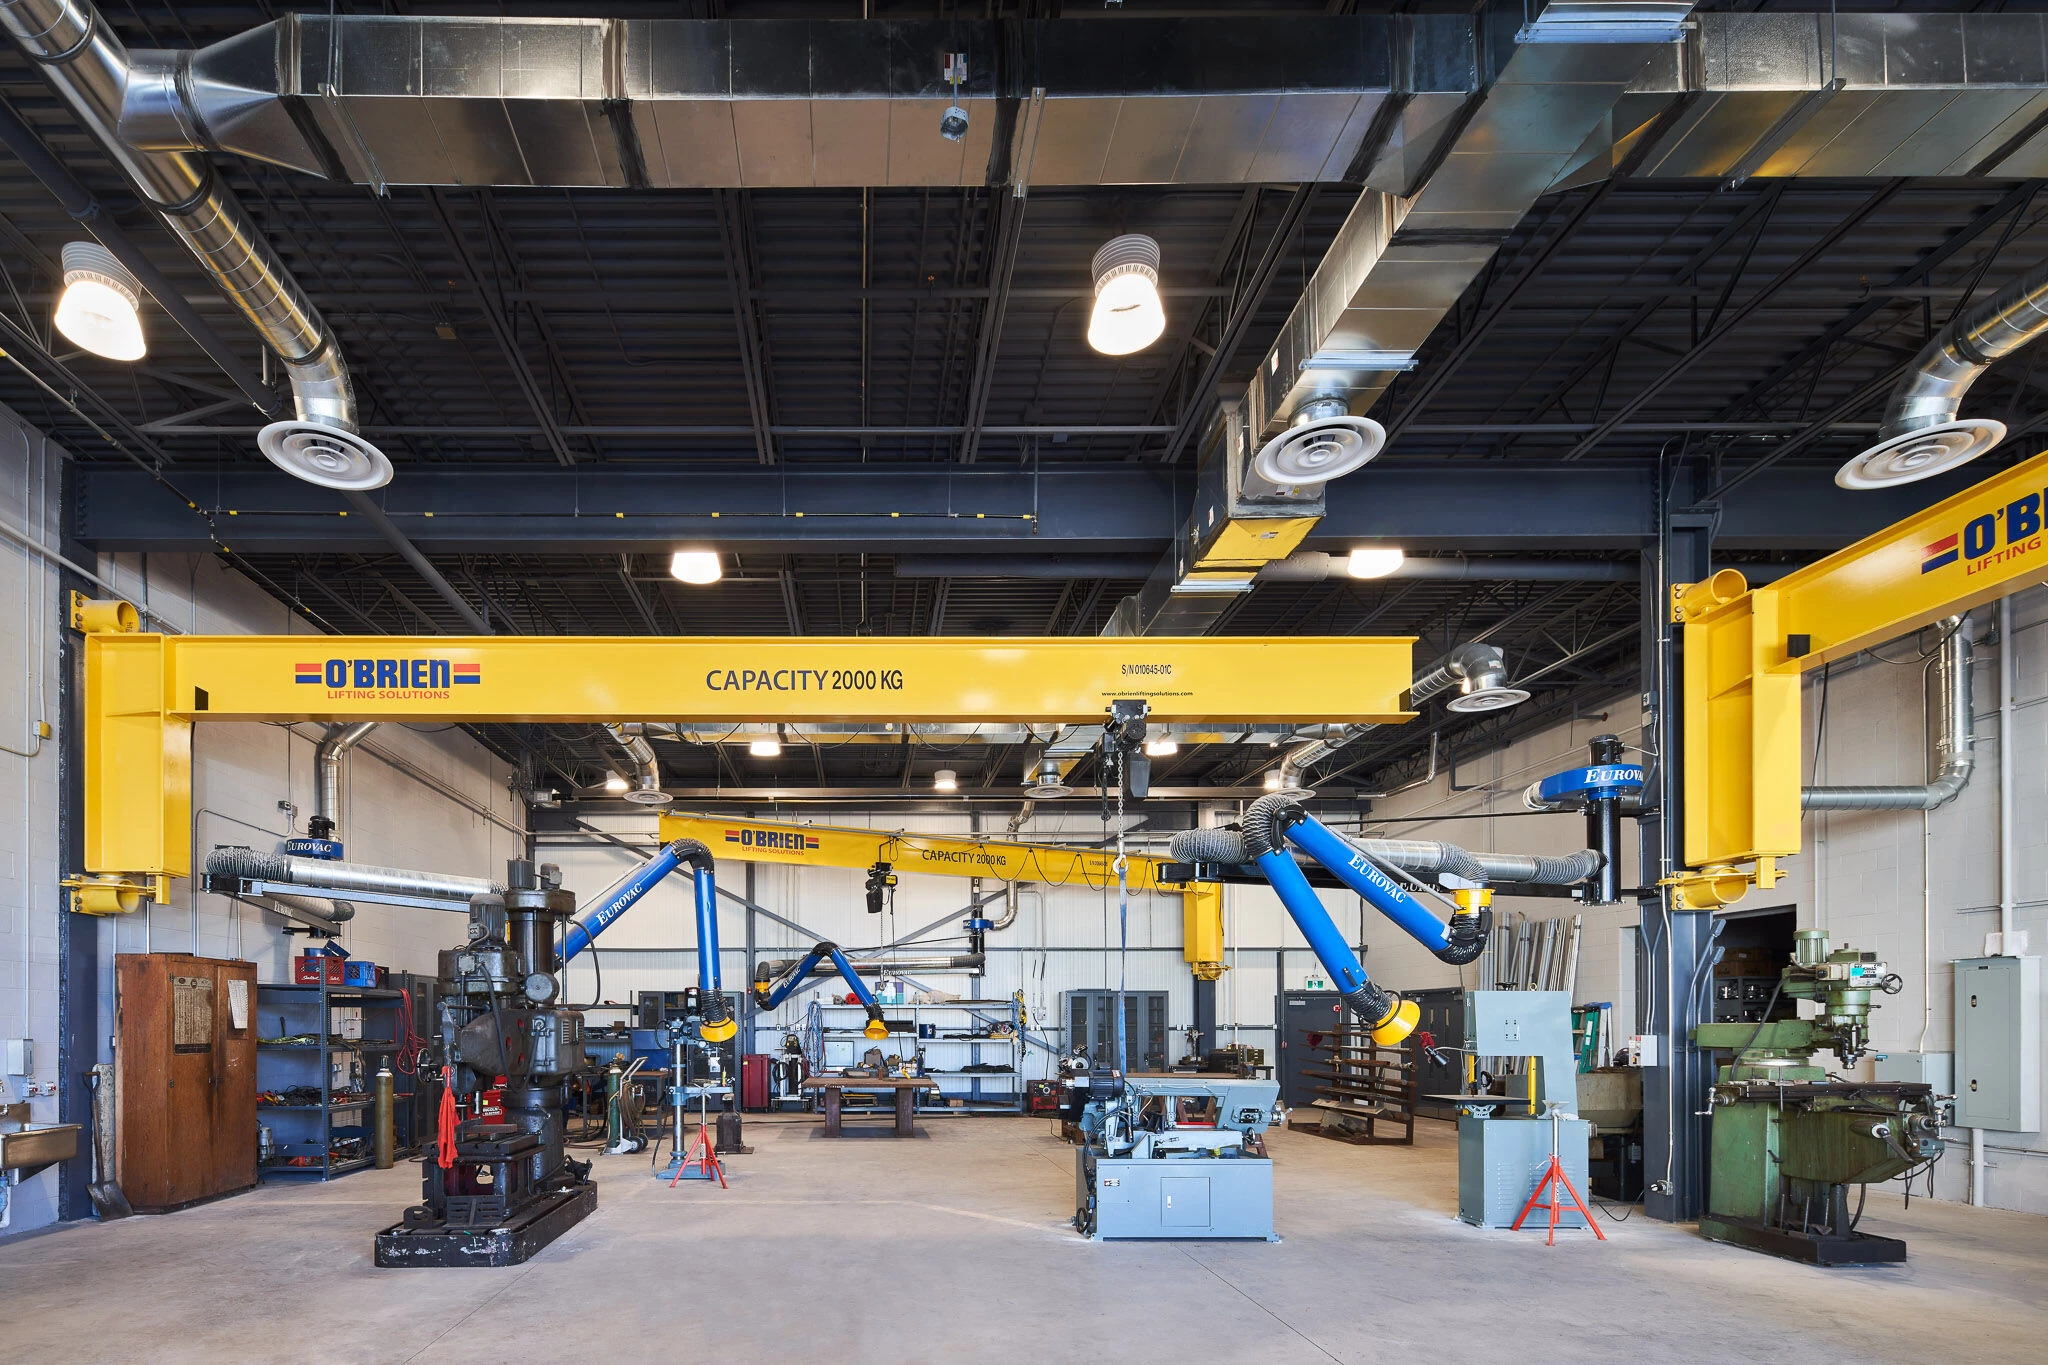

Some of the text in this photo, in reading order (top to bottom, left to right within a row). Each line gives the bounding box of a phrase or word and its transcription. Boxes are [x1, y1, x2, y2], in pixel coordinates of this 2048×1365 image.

[1967, 537, 2041, 576] LIFTING
[325, 659, 451, 688] O'BRIEN
[706, 669, 903, 690] CAPACITY 2000 KG
[1121, 664, 1172, 676] S/N 010645-01C
[327, 690, 450, 699] LIFTING SOLUTIONS
[287, 841, 332, 853] EUROVAC
[768, 848, 805, 856] SOLUTIONS
[922, 849, 975, 864] CAPACITY
[996, 855, 1007, 866] KG
[1347, 853, 1406, 903] EUROVAC
[596, 882, 643, 926] EUROVAC
